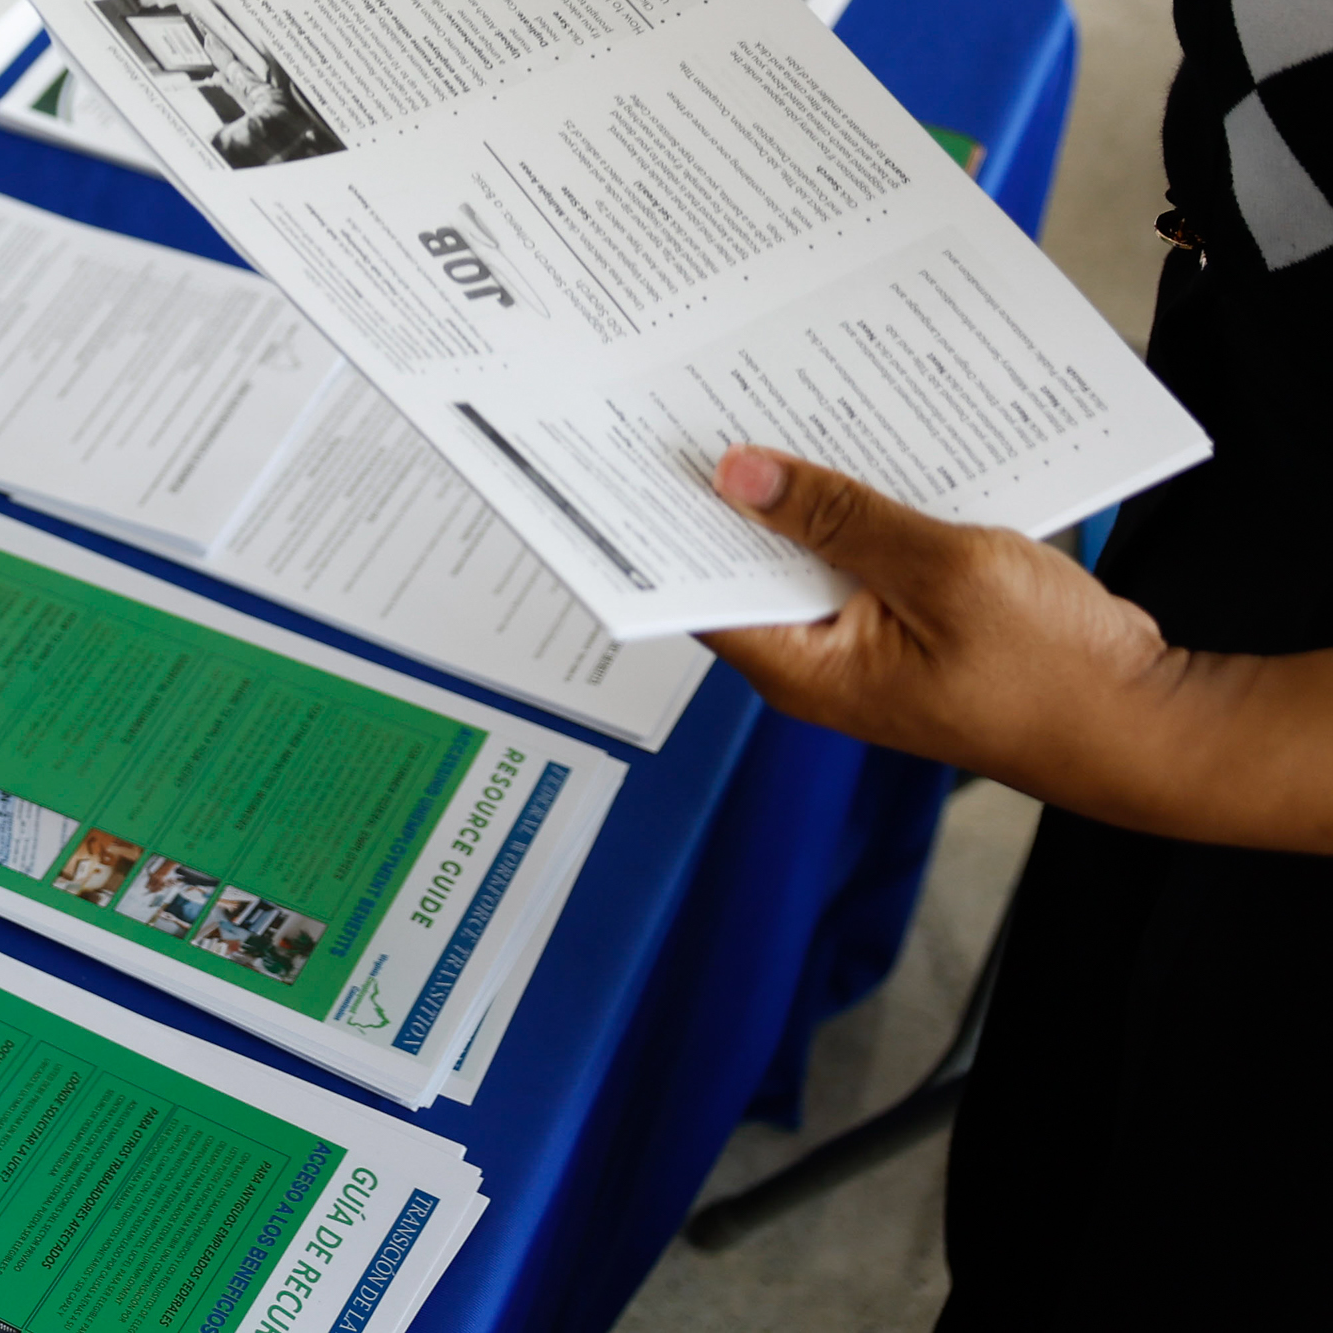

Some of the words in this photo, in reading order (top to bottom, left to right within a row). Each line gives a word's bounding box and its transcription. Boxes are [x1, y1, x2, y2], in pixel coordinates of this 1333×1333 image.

[549, 10, 571, 28] Save
[608, 0, 627, 12] to
[618, 11, 647, 34] How
[565, 27, 586, 45] Click
[466, 171, 498, 199] Basic
[813, 164, 843, 190] Search
[837, 190, 859, 208] Click
[497, 209, 539, 250] Criteria:
[411, 223, 519, 315] JOB
[530, 249, 570, 288] Search
[560, 286, 615, 344] Suggested
[572, 279, 611, 317] Search
[603, 316, 630, 339] Job
[421, 726, 475, 797] ACCESSING
[449, 746, 527, 856] RESOURCE
[514, 764, 568, 837] FEDERAL
[363, 795, 435, 898] UNEMPLOYMENT
[408, 858, 464, 929] GUIDE
[457, 838, 528, 943] WORKFORCE
[327, 895, 376, 959] BENEFITS
[398, 943, 472, 1053] TRANSITION
[51, 1070, 84, 1106] ¿DÓNDE
[23, 1103, 60, 1145] SOLICITAR
[135, 1106, 159, 1130] PARA
[14, 1142, 32, 1156] LA
[116, 1128, 144, 1158] OTROS
[72, 1156, 124, 1221] TRABAJADORES
[248, 1159, 273, 1185] PARA
[283, 1141, 335, 1204] ACCESO
[220, 1182, 258, 1228] ANTIGUOS
[273, 1200, 297, 1219] A
[324, 1164, 389, 1231] GUÍA
[39, 1219, 81, 1269] AFECTADOS
[254, 1213, 289, 1249] LOS
[302, 1224, 345, 1265] DE
[362, 1194, 437, 1294] TRANSICIÓN
[186, 1225, 230, 1280] EMPLEADOS
[156, 1277, 196, 1328] FEDERALES
[197, 1245, 269, 1333] BENEFICIOS
[351, 1287, 377, 1310] DE
[336, 1308, 364, 1333] LA
